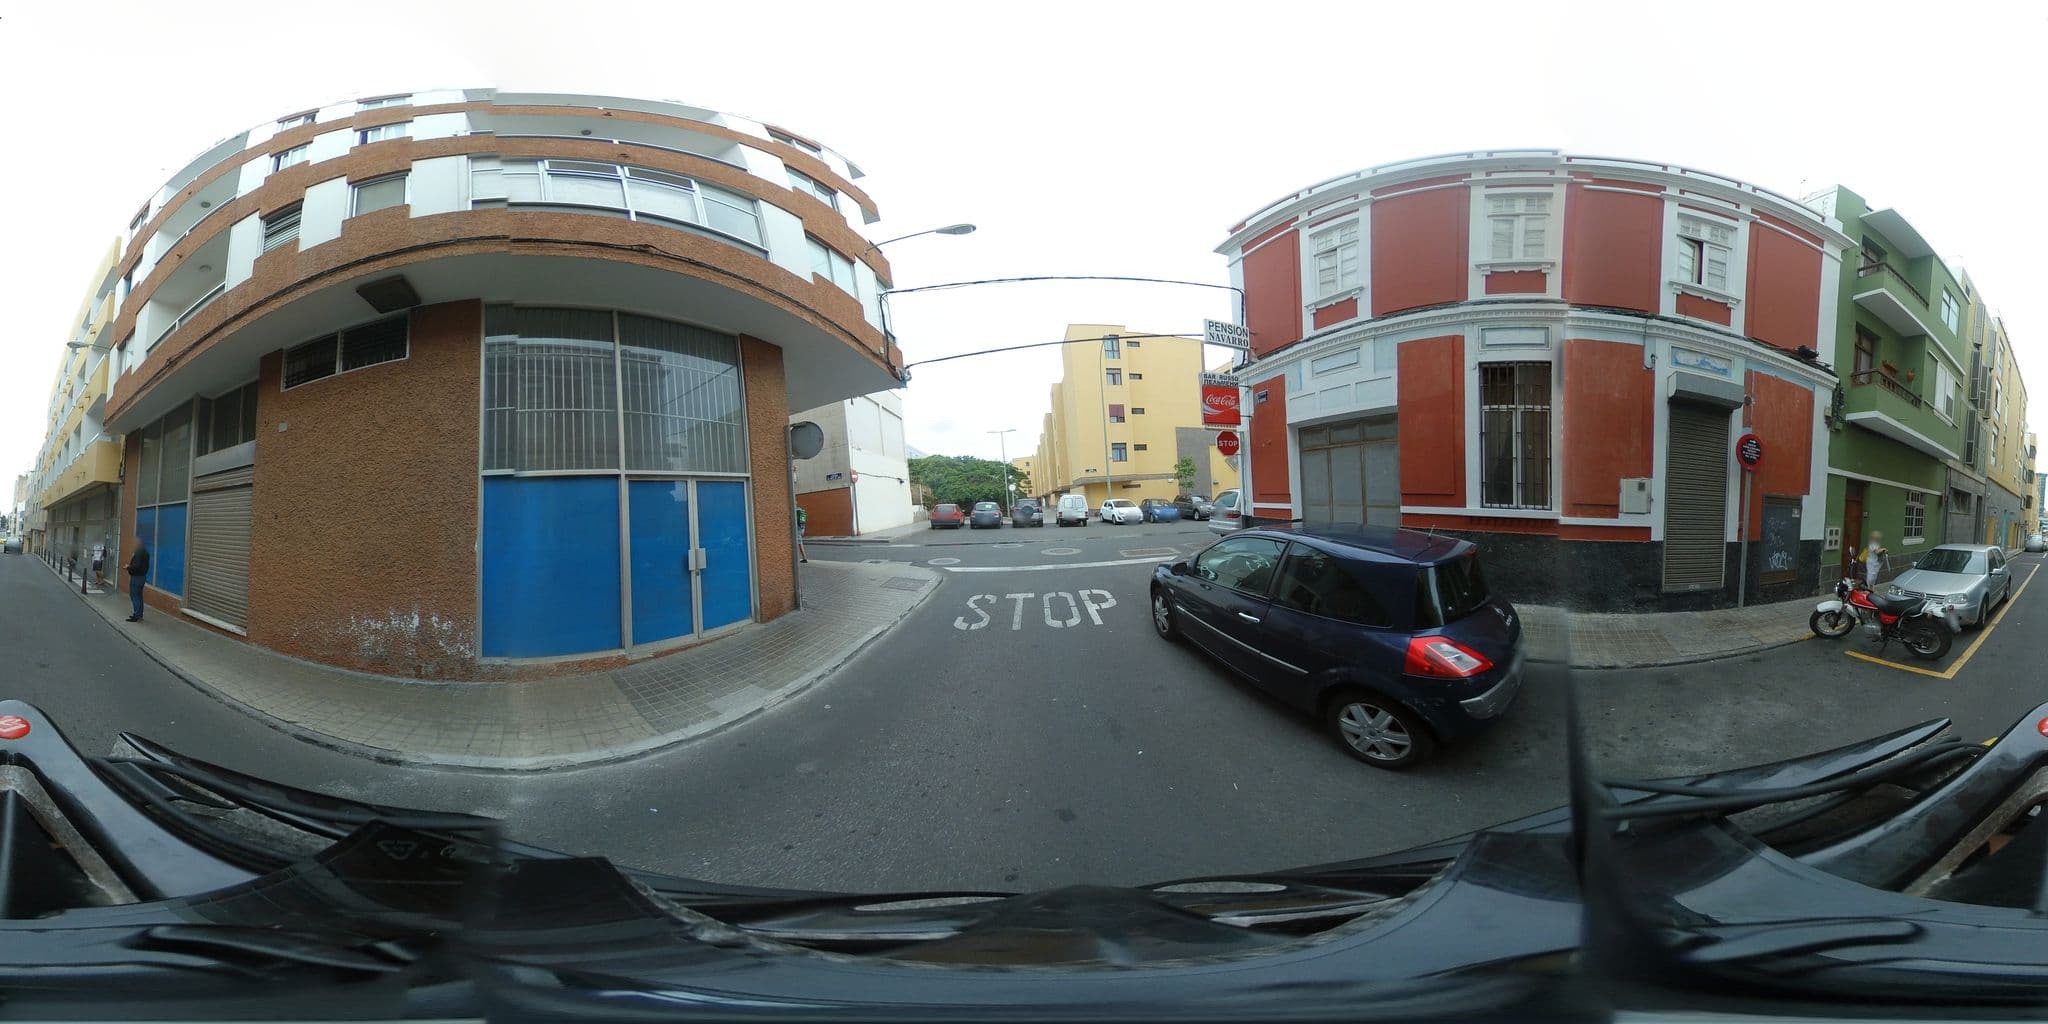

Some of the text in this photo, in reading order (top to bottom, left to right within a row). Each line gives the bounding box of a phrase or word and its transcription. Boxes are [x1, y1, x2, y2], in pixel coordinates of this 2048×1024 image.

[1208, 320, 1249, 338] PENSION
[1209, 332, 1249, 347] NAVARRO
[1219, 374, 1239, 382] RUSSO
[1218, 439, 1238, 448] STOP
[953, 589, 1118, 631] STOP
